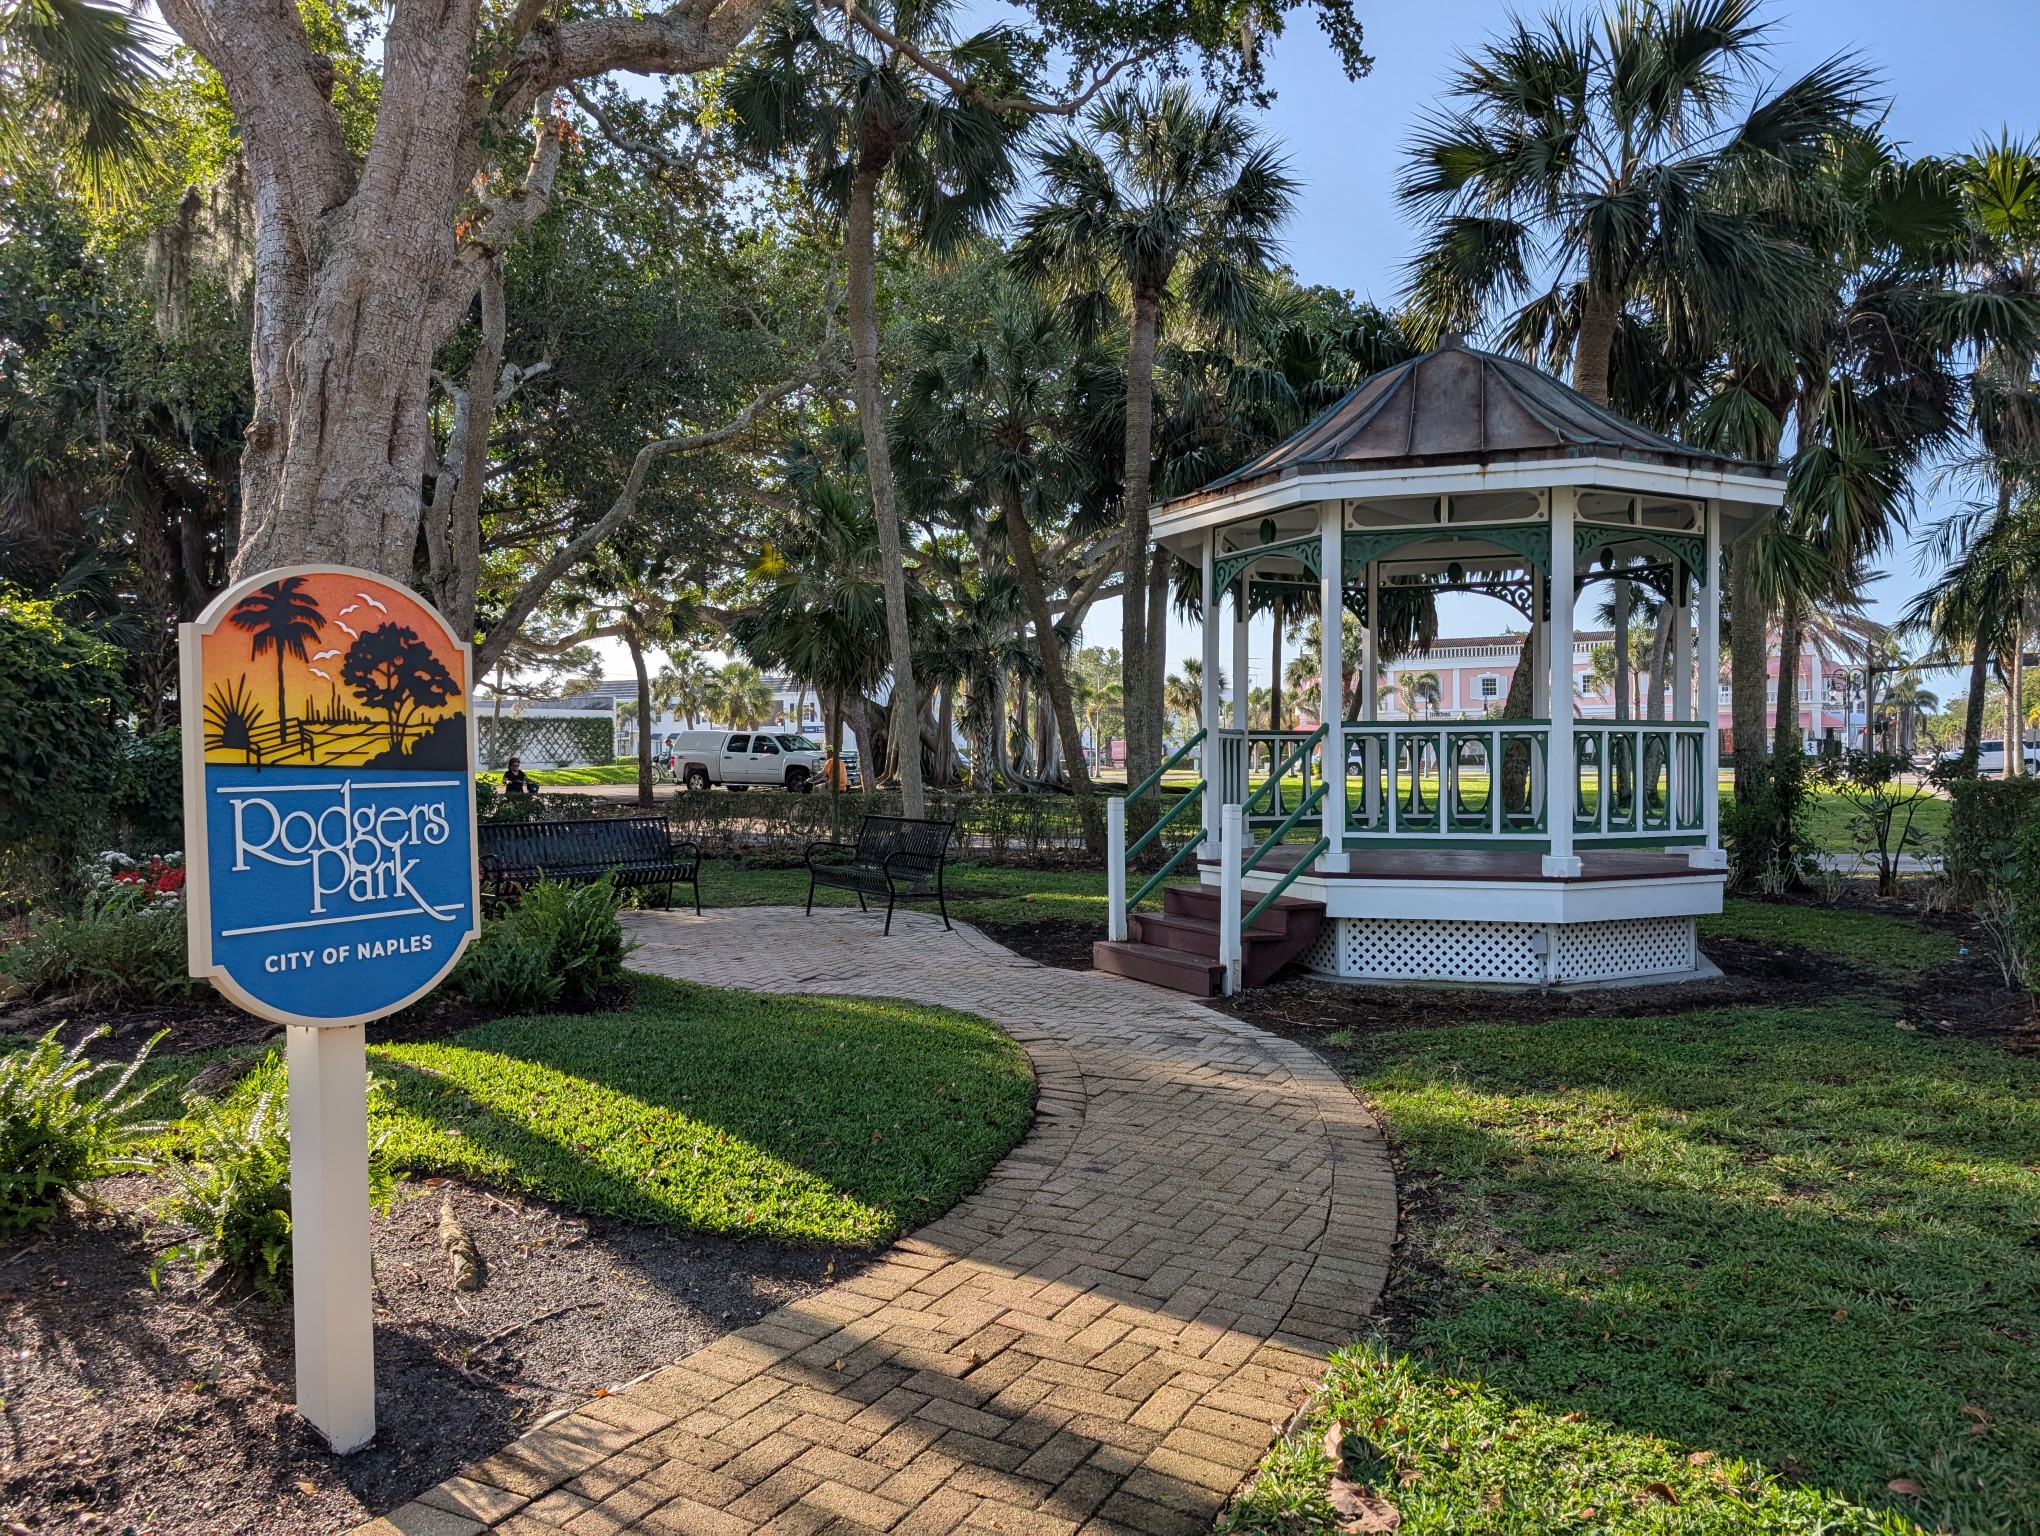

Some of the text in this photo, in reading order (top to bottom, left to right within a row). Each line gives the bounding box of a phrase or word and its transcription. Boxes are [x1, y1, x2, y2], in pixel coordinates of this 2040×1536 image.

[229, 779, 450, 872] Rodgers
[308, 841, 456, 921] Park
[264, 934, 433, 973] CITY OF NAPLES
